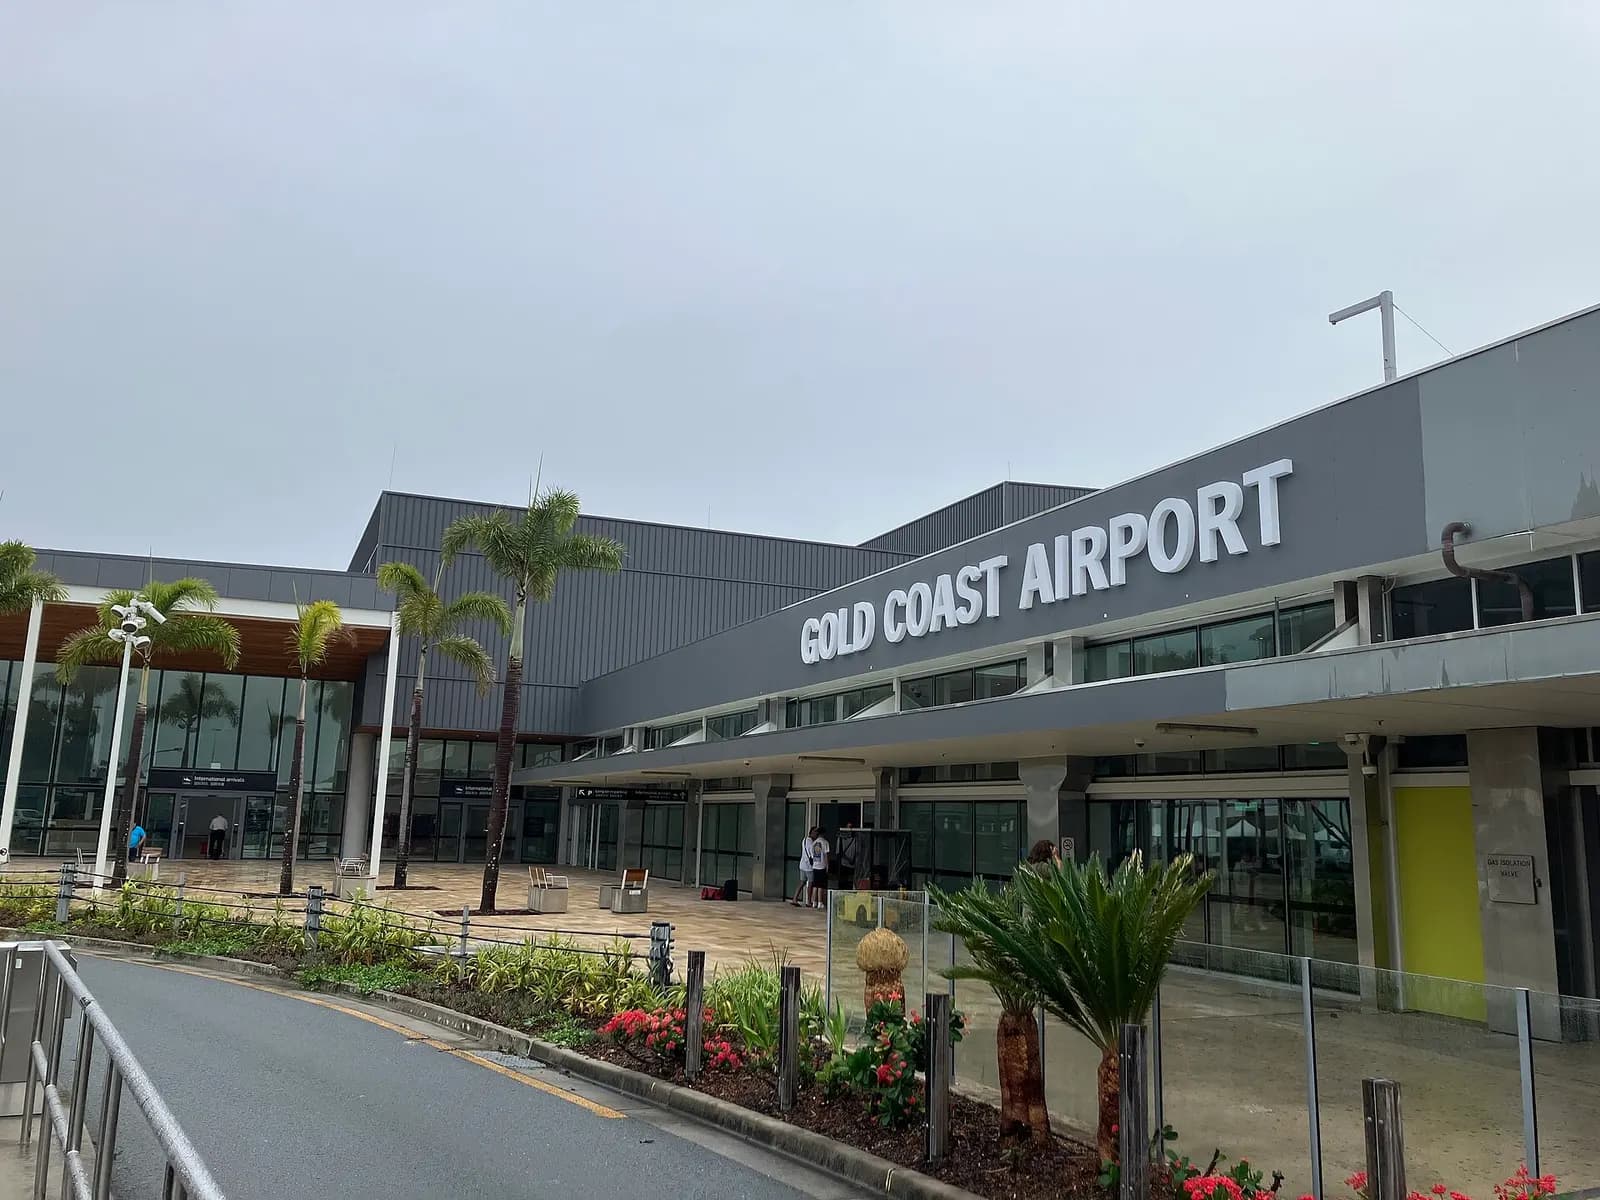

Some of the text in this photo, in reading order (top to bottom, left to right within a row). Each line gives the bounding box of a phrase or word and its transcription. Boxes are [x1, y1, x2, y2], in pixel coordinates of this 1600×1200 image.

[800, 458, 1294, 665] GOLD COAST AIRPORT
[1500, 859, 1531, 867] ISOLATION
